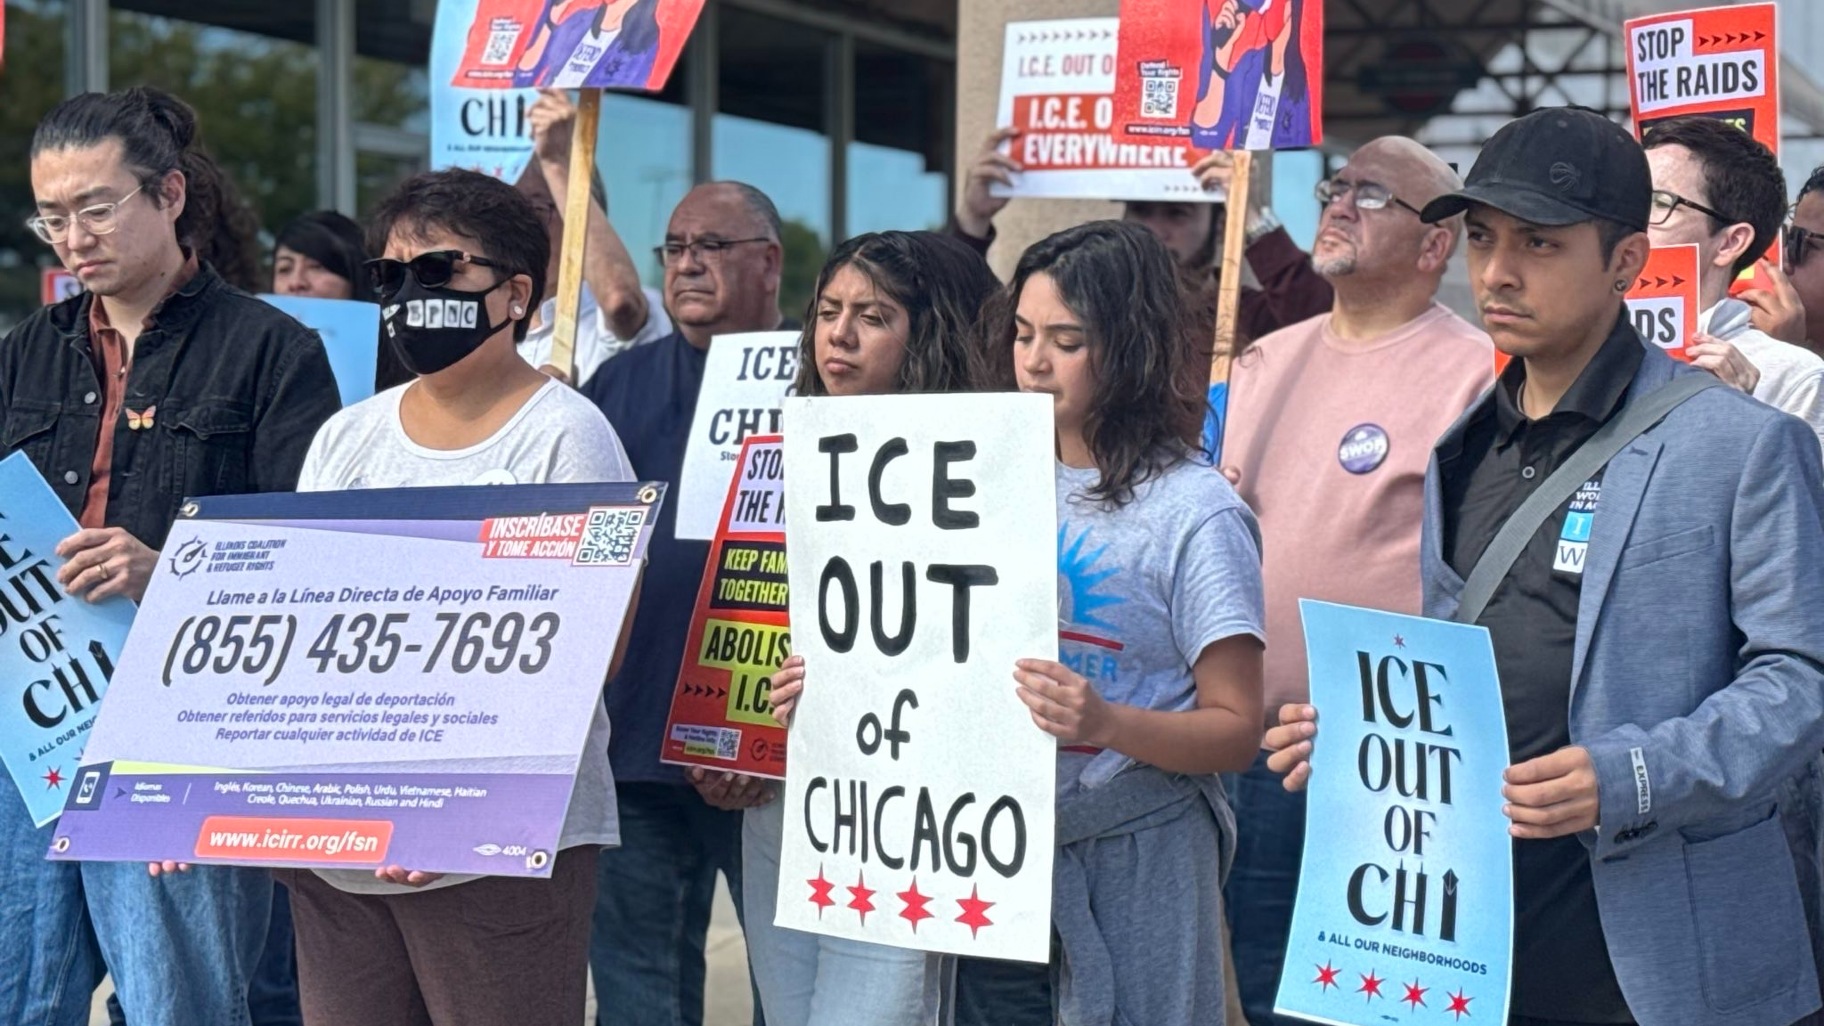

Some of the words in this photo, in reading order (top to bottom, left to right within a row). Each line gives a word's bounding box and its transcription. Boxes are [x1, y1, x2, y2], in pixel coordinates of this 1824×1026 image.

[1638, 27, 1684, 62] STOP
[1062, 54, 1096, 76] OUT
[1637, 68, 1669, 103] THE
[1677, 60, 1758, 98] RAIDS
[461, 92, 525, 138] CHI
[1029, 96, 1087, 130] I.C.E.
[1024, 133, 1188, 168] EVERYWHERE
[737, 346, 798, 381] ICE
[747, 448, 784, 481] STO
[815, 432, 980, 530] ICE
[734, 489, 773, 525] THE
[489, 511, 585, 539] INSCRÍBASE
[210, 552, 226, 561] FOR
[227, 551, 270, 560] IMMIGRANT
[215, 540, 247, 551] ILLINOIS
[247, 539, 287, 550] COALITION
[486, 540, 498, 557] Y
[497, 540, 533, 557] TOME
[529, 538, 577, 557] ACCIÓN
[724, 548, 759, 572] KEEP
[1560, 545, 1585, 567] W
[213, 562, 245, 572] REFUGEE
[245, 561, 275, 571] RIGHTS
[206, 590, 255, 605] Llame
[257, 593, 268, 604] a
[271, 588, 287, 604] la
[289, 587, 335, 603] Línea
[338, 586, 399, 603] Directa
[403, 585, 425, 602] de
[426, 585, 483, 605] Apoyo
[486, 584, 560, 601] Familiar
[718, 578, 788, 606] TOGETHER
[818, 555, 999, 664] OUT
[19, 614, 65, 663] OF
[162, 614, 297, 687] (855)
[306, 611, 560, 675] 435-7693
[227, 693, 278, 706] Obtener
[279, 696, 319, 708] apoyo
[321, 692, 353, 708] legal
[356, 692, 372, 706] de
[374, 692, 455, 708] deportación
[1356, 650, 1453, 737] ICE
[177, 709, 228, 722] Obtener
[229, 709, 286, 722] referidos
[287, 712, 317, 725] para
[319, 710, 379, 724] servicios
[380, 710, 429, 726] legales
[430, 713, 440, 727] y
[442, 711, 498, 724] sociales
[856, 688, 919, 761] of
[38, 742, 56, 757] ALL
[56, 728, 77, 745] OUR
[215, 728, 272, 743] Reportar
[273, 728, 334, 743] cualquier
[335, 728, 397, 742] actividad
[399, 729, 417, 742] de
[418, 729, 445, 742] ICE
[1358, 733, 1462, 805] OUT
[214, 781, 240, 794] Inglés,
[242, 782, 274, 793] Korean,
[276, 782, 311, 794] Chinese,
[454, 786, 487, 798] Haitian
[365, 796, 398, 807] Russian
[400, 797, 418, 808] and
[419, 798, 445, 809] Hindi
[1636, 765, 1650, 812] EXPRESS
[210, 828, 378, 856] www.icirr.org/fsn
[804, 776, 1027, 878] CHICAGO
[1384, 804, 1437, 855] OF
[1347, 858, 1459, 942] CHI
[1318, 931, 1326, 941] &
[1329, 933, 1351, 947] ALL
[1354, 938, 1380, 953] OUR
[1382, 944, 1487, 976] NEIGHBORHOODS
